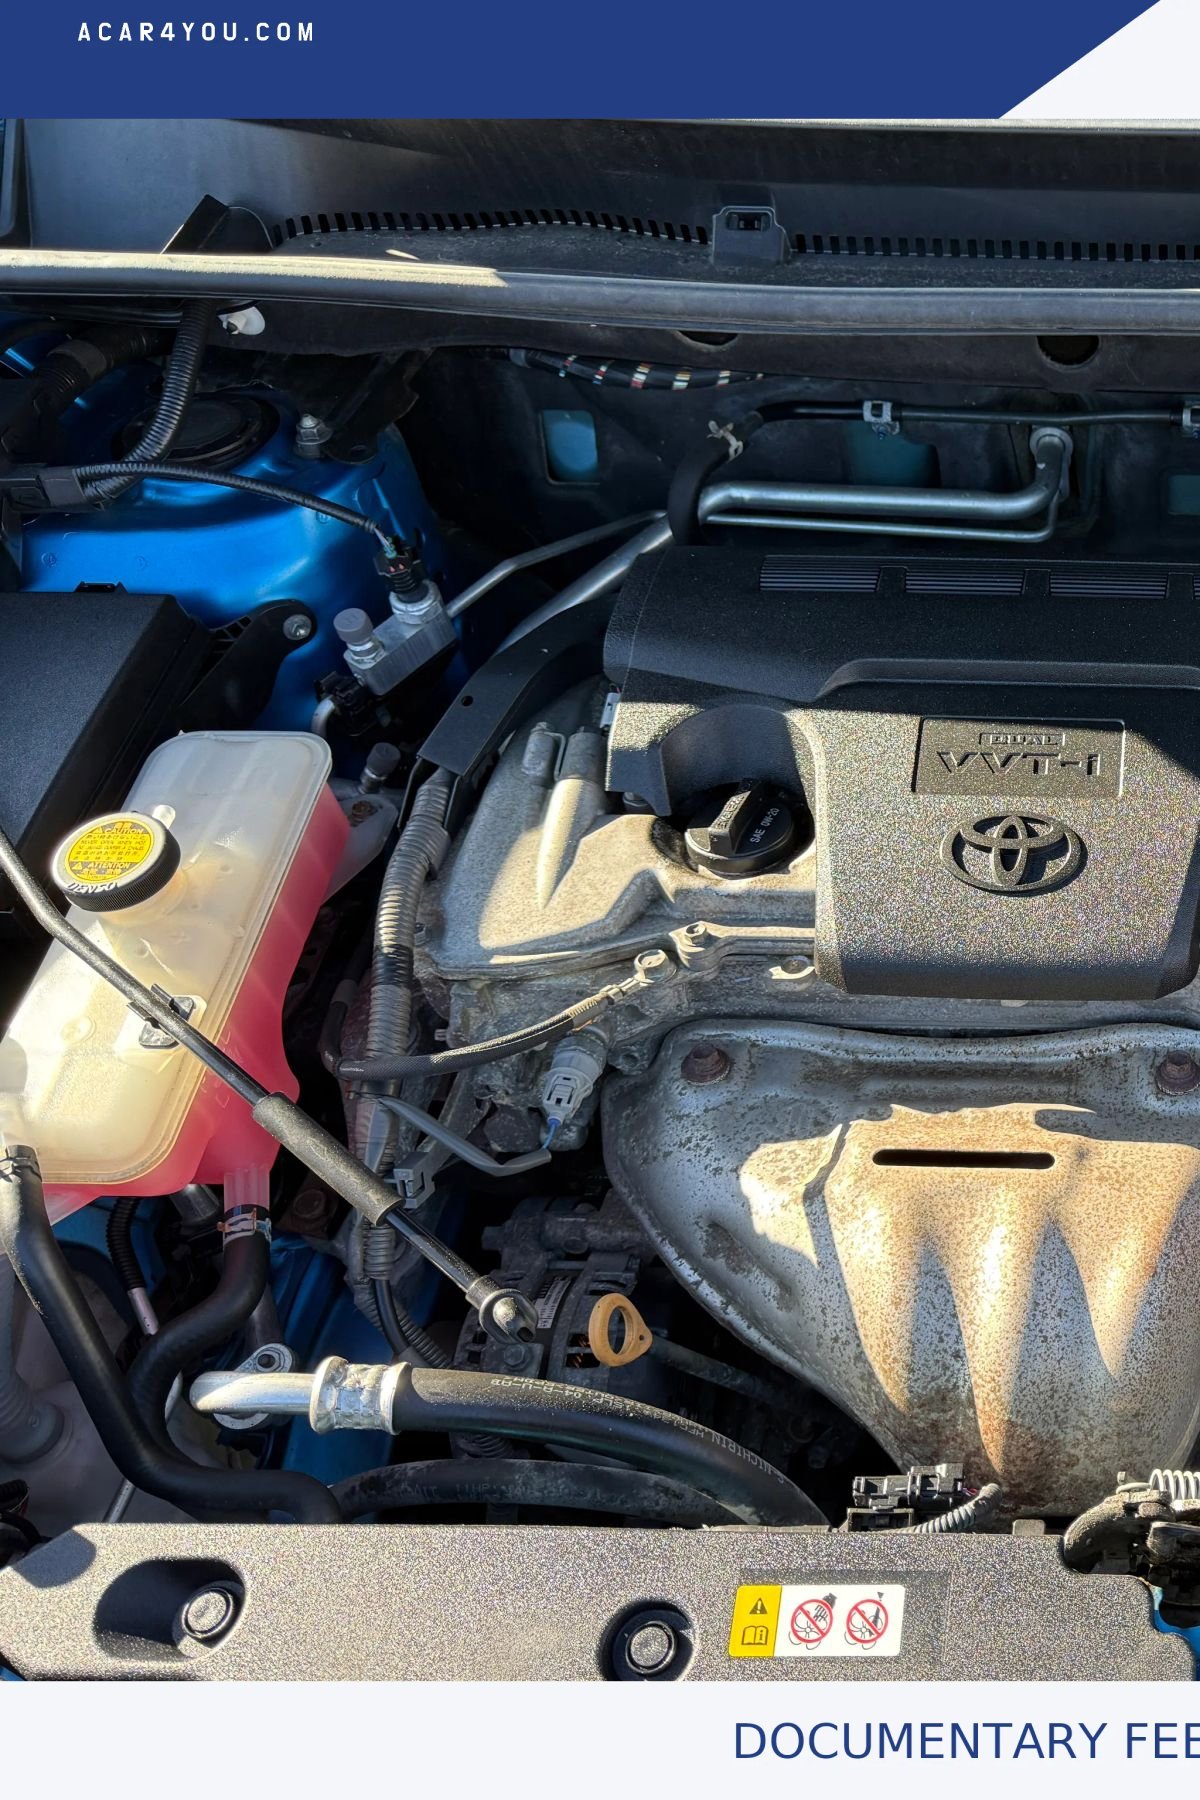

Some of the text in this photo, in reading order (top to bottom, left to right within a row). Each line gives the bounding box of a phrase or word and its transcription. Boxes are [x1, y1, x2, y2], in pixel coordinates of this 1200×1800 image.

[989, 733, 1060, 746] DUAL
[750, 807, 780, 843] SAE 0W-20
[87, 862, 130, 870] ATTENTION
[67, 882, 118, 894] DENSO
